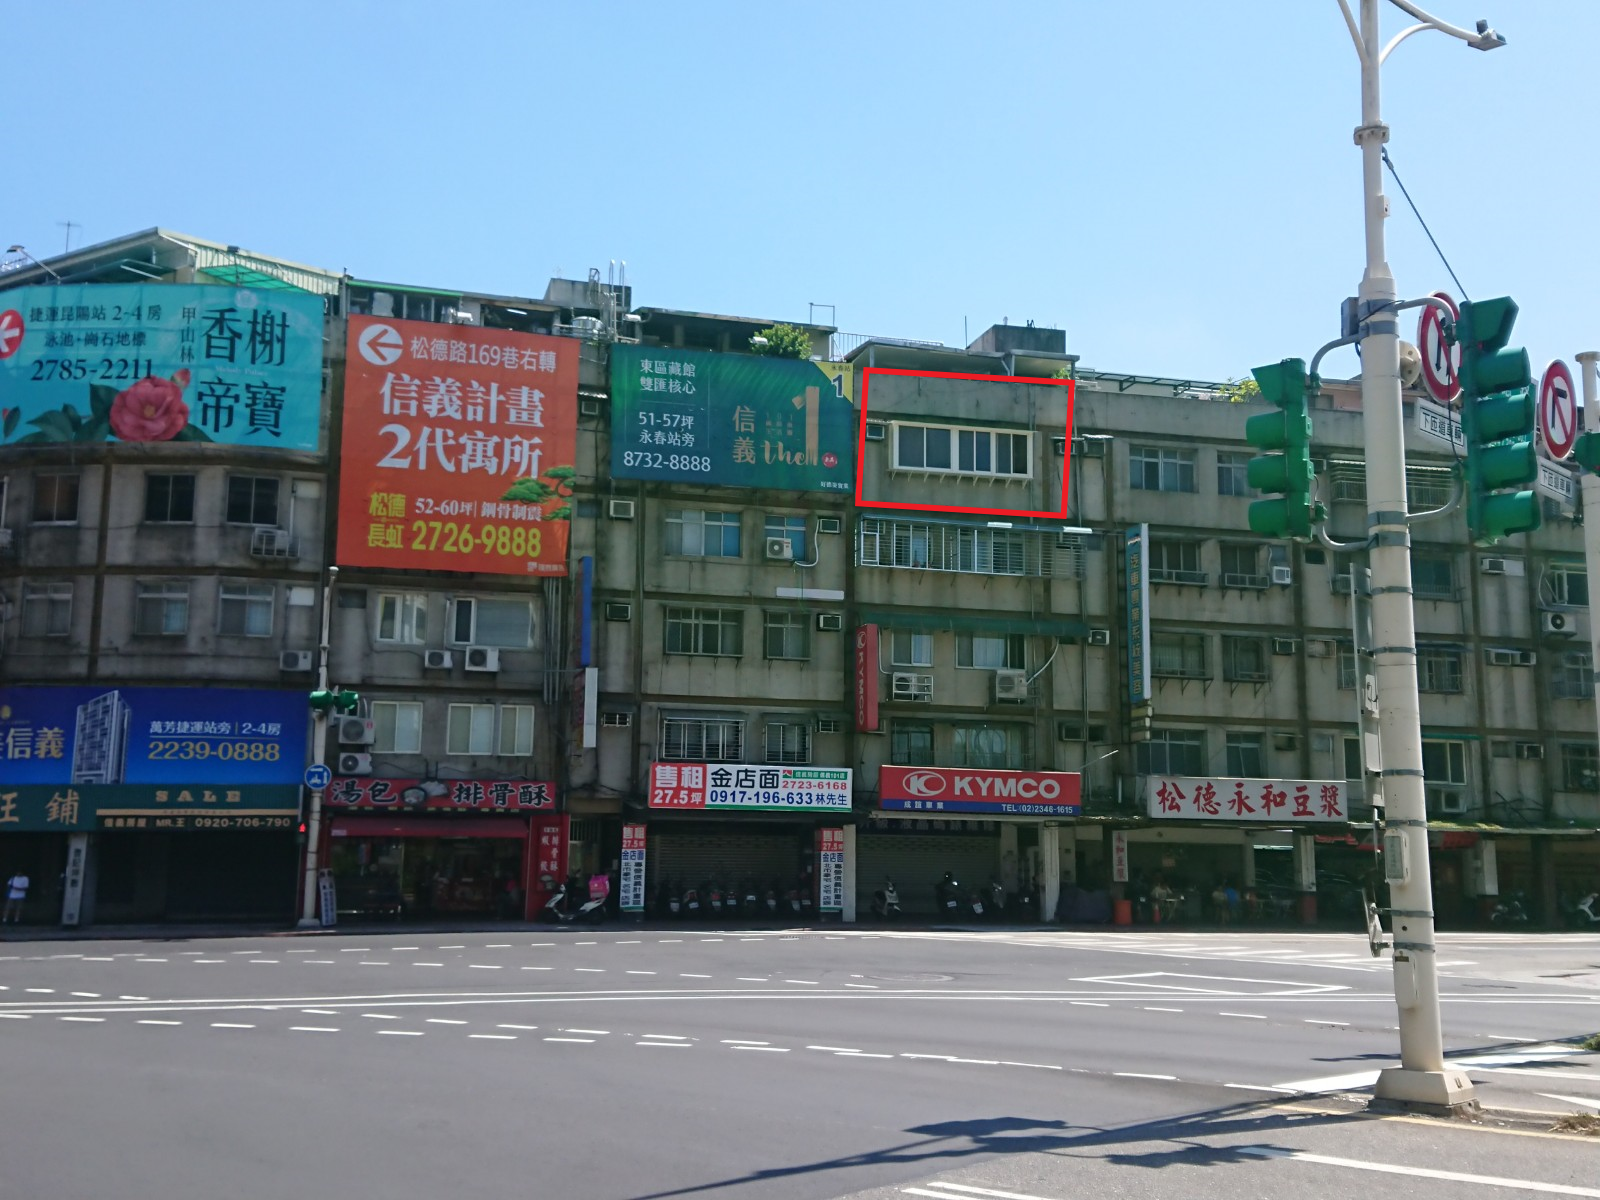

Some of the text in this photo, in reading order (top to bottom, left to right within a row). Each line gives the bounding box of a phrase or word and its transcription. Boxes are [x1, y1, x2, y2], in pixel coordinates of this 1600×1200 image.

[28, 305, 106, 321] 捷運昆陽站
[147, 304, 162, 321] 房
[180, 306, 197, 363] 甲山林
[201, 307, 290, 366] 香榭
[410, 336, 556, 373] 松德路169巷右轉
[30, 358, 153, 381] 2785-2211
[640, 359, 696, 377] 東區藏館
[640, 377, 696, 395] 雙匯核心
[831, 373, 844, 398] 1
[197, 376, 287, 437] 帝寶
[380, 371, 545, 428] 信義計畫
[639, 411, 694, 429] 51-57坪
[639, 429, 695, 447] 永春站旁
[732, 405, 757, 464] 信義
[376, 423, 543, 479] 2代寓所
[623, 451, 711, 472] 8732-8888
[369, 492, 405, 517] 松德
[415, 498, 473, 517] 52-60坪
[367, 523, 404, 548] 長虹
[411, 520, 541, 557] 2726-9888
[149, 721, 281, 736] 萬芳捷運站旁 2-4房
[148, 742, 280, 761] 2239-0888
[655, 765, 704, 789] 售租
[711, 767, 780, 789] 金店面
[782, 780, 847, 790] 2723-6168
[954, 776, 1061, 799] KYMCO
[155, 790, 241, 803] SALE
[332, 779, 551, 806] 湯包 排骨酥
[710, 790, 848, 806] 0917-196-633 林先生
[1156, 780, 1343, 818] 松德永和豆漿
[195, 817, 291, 828] 0920-706-790
